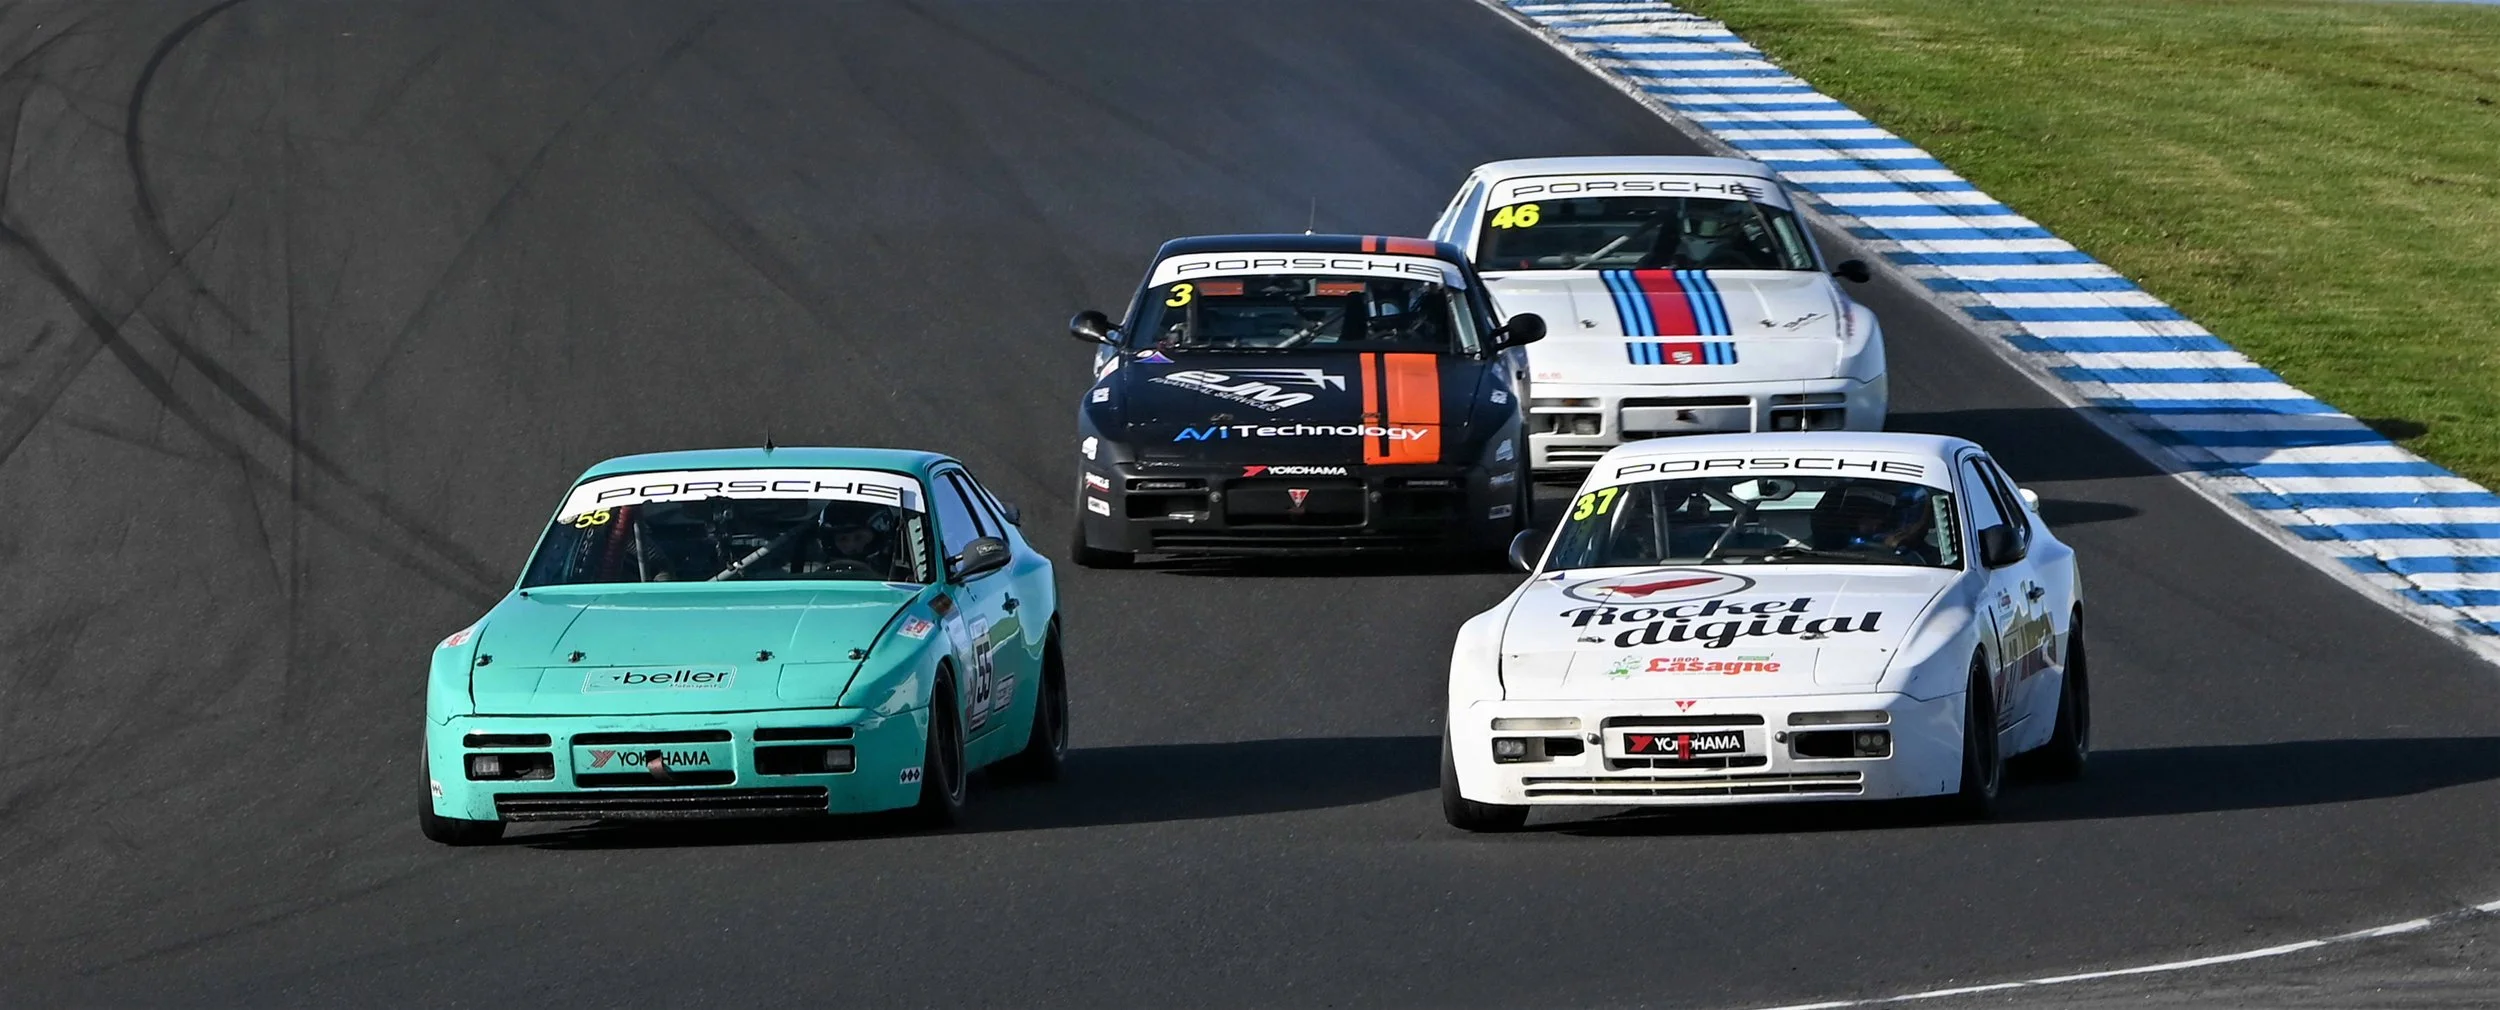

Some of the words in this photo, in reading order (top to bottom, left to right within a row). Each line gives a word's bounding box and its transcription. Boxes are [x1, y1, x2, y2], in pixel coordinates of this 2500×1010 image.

[1513, 181, 1763, 199] PORSCHE
[1491, 204, 1540, 229] 46
[1177, 258, 1441, 278] PORSCHE
[1165, 283, 1194, 308] 3
[1214, 391, 1281, 412] SERVICES
[1231, 423, 1428, 441] Technology
[1267, 465, 1348, 476] YOKOHAMA
[1616, 457, 1924, 480] PORSCHE
[597, 480, 900, 503] PORSCHE
[1573, 487, 1619, 522] 37
[575, 507, 611, 529] 55
[1559, 597, 1816, 628] Rocket
[1613, 611, 1883, 650] digital
[622, 669, 729, 684] beller
[976, 641, 991, 704] 55
[1645, 658, 1781, 675] Lasagne
[1654, 735, 1741, 752] YOHAMA
[617, 750, 711, 767] YOKHAMA
